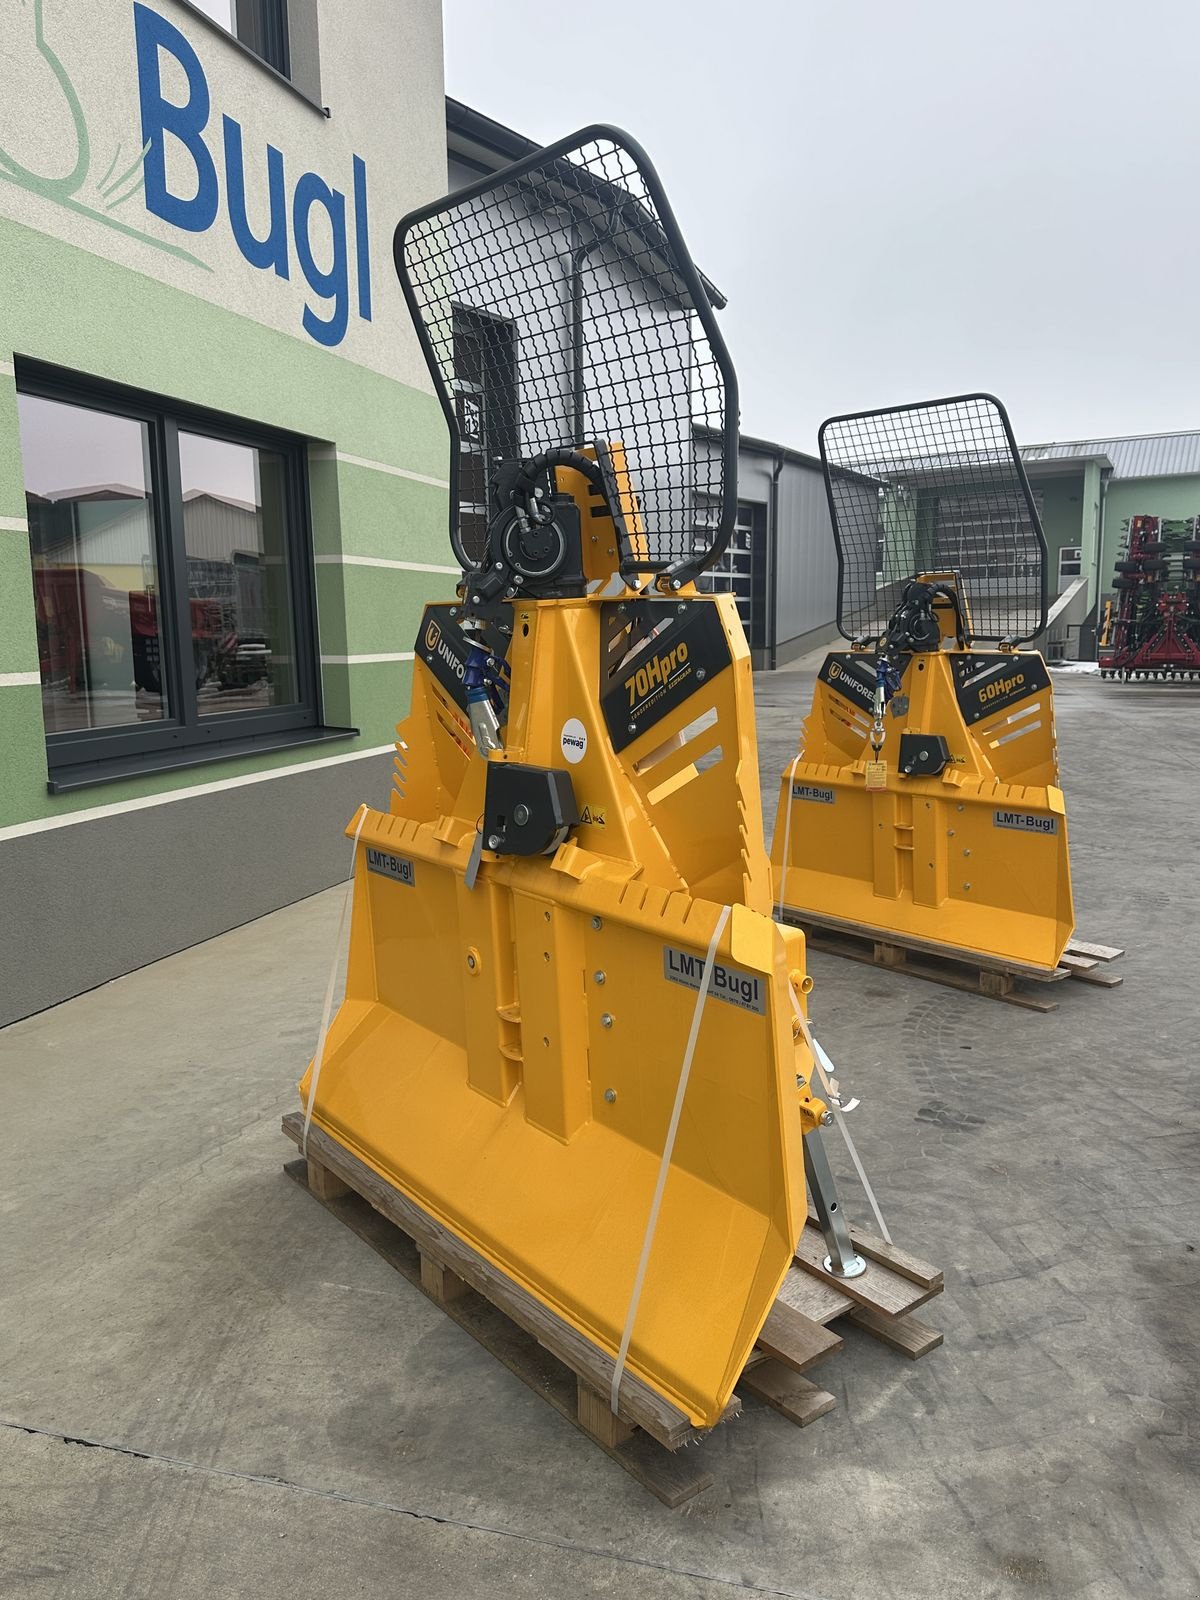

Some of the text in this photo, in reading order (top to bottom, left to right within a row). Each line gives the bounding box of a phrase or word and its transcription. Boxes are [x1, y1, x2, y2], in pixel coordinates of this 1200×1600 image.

[133, 1, 372, 346] Bugl
[437, 639, 465, 684] UNIFO
[625, 642, 688, 707] 70Hpro
[978, 673, 1025, 703] 60Hpro
[562, 737, 584, 750] pewag
[792, 785, 833, 801] LMT-Bugl
[996, 811, 1054, 831] LMT-Bugl
[368, 849, 412, 880] LMT-Bugl
